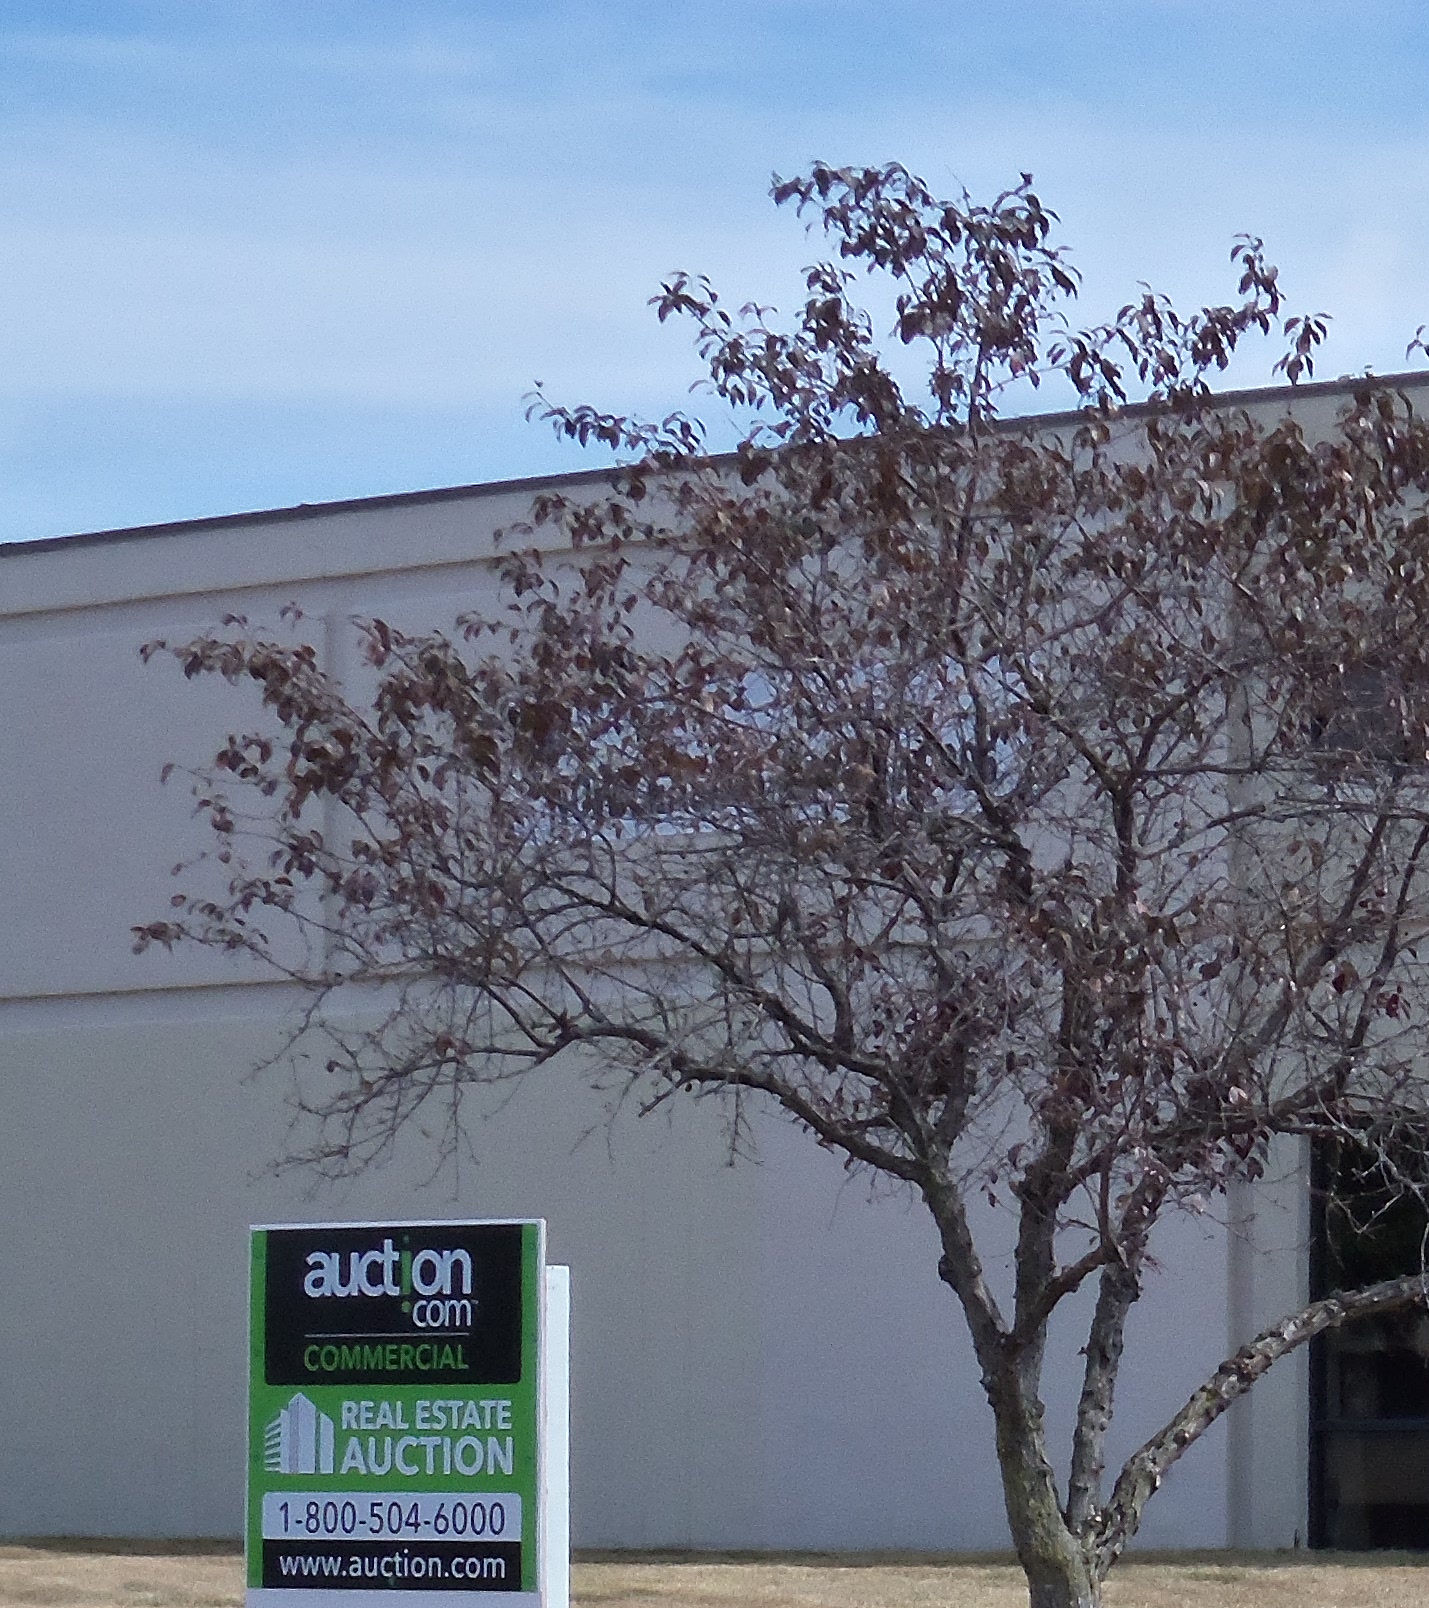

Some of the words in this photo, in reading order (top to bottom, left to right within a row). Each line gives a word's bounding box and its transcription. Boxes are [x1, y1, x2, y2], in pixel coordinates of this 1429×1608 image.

[304, 1235, 472, 1298] auction
[304, 1344, 469, 1371] COMMERCIAL
[341, 1401, 408, 1430] REAL
[416, 1400, 511, 1430] ESTATE
[340, 1436, 513, 1476] AUCTION
[279, 1501, 505, 1534] 1-800-504-6000
[279, 1549, 506, 1579] www.auction.com
